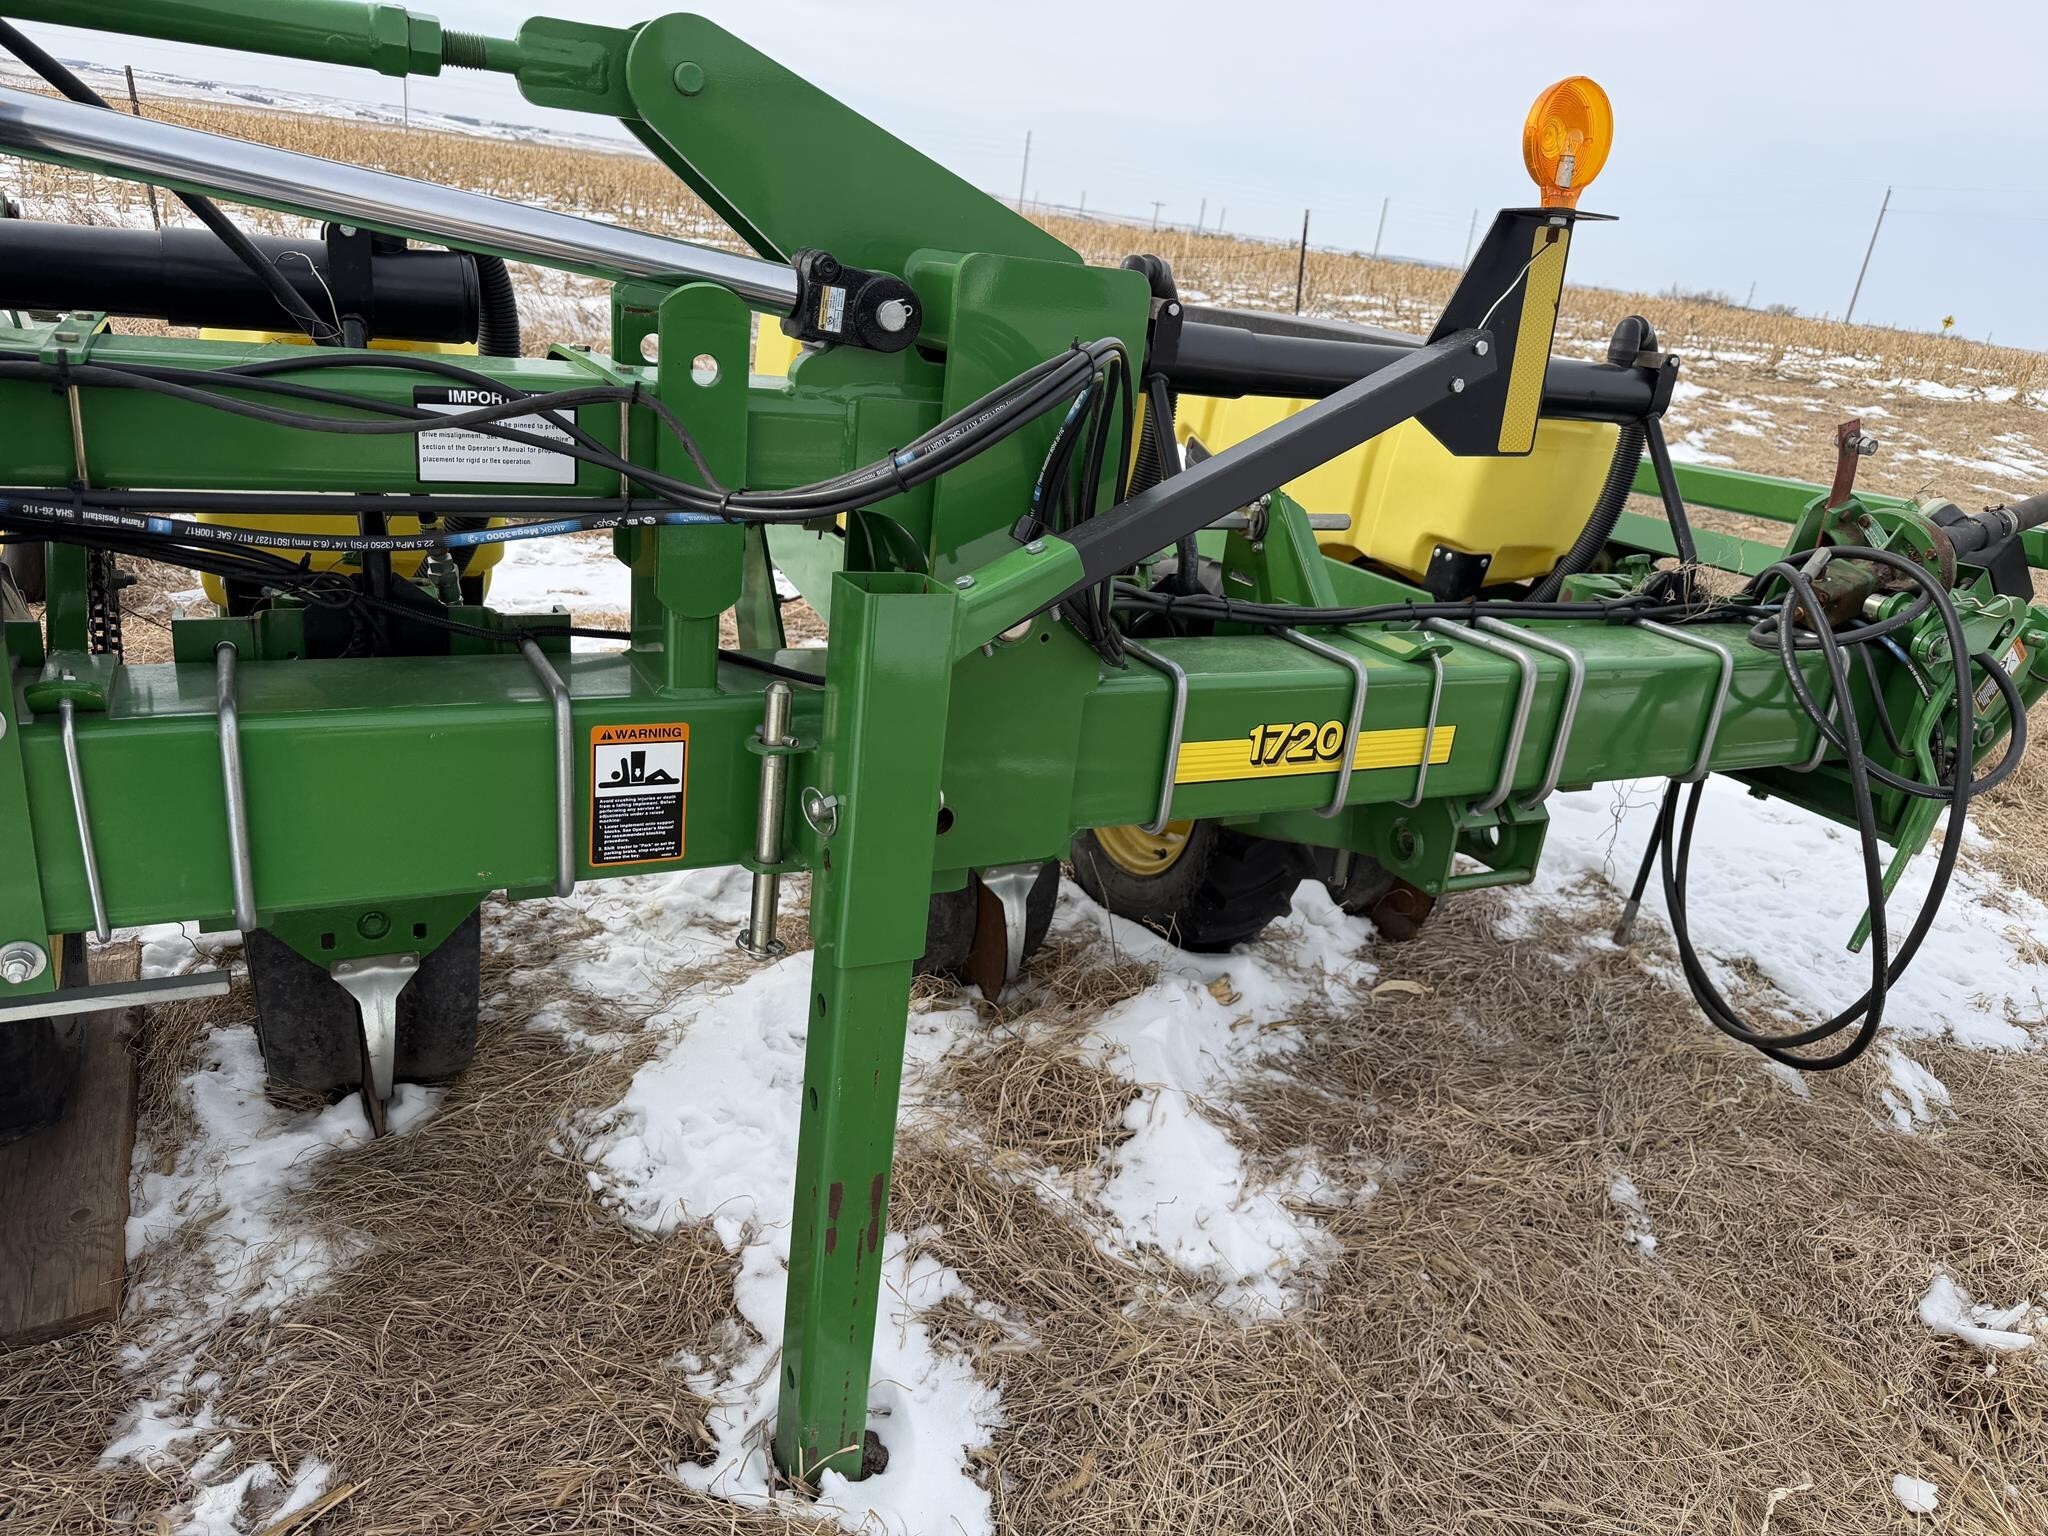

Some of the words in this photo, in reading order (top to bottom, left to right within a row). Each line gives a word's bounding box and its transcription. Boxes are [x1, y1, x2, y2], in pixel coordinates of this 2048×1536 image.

[514, 422, 536, 430] pinned
[468, 445, 500, 454] Operator's
[422, 456, 455, 464] placement
[466, 456, 480, 466] rigid
[22, 504, 54, 516] 2G-11C
[56, 508, 74, 518] SHA
[82, 511, 120, 524] Resistant
[120, 516, 145, 528] Flame
[184, 526, 214, 538] 100R17
[540, 524, 566, 534] 4M3K
[216, 530, 232, 540] SAE
[238, 534, 254, 543] R17
[292, 538, 311, 546] mm)
[313, 540, 330, 549] (6.3
[350, 540, 368, 549] PSI)
[370, 540, 394, 549] (3250
[396, 540, 414, 548] MPa
[416, 540, 435, 548] 22.5
[615, 727, 682, 740] WARNING
[1249, 720, 1345, 766] 1720
